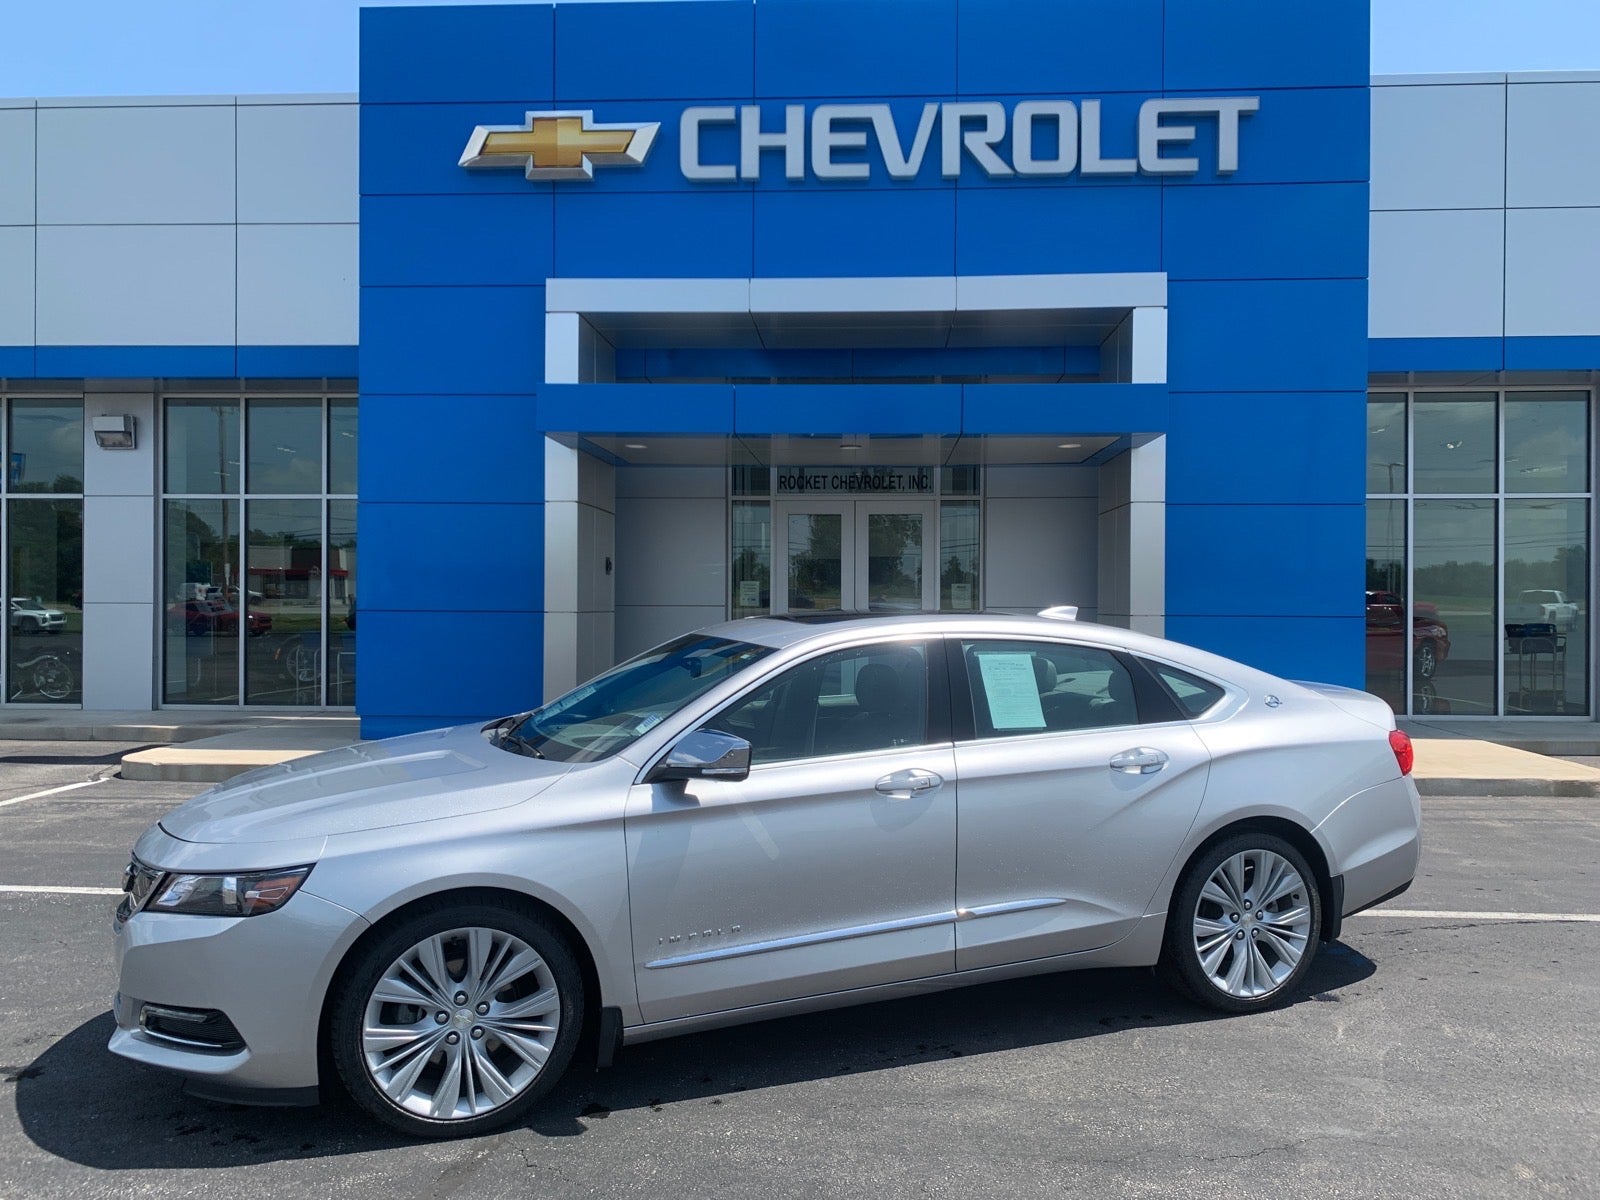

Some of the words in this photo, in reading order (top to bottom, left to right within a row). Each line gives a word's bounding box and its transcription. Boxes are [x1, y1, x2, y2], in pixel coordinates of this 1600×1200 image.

[679, 96, 1260, 183] CHEVROLET
[779, 475, 828, 490] ROCKET
[831, 475, 905, 492] CHEVROLET,
[908, 475, 932, 490] INC.
